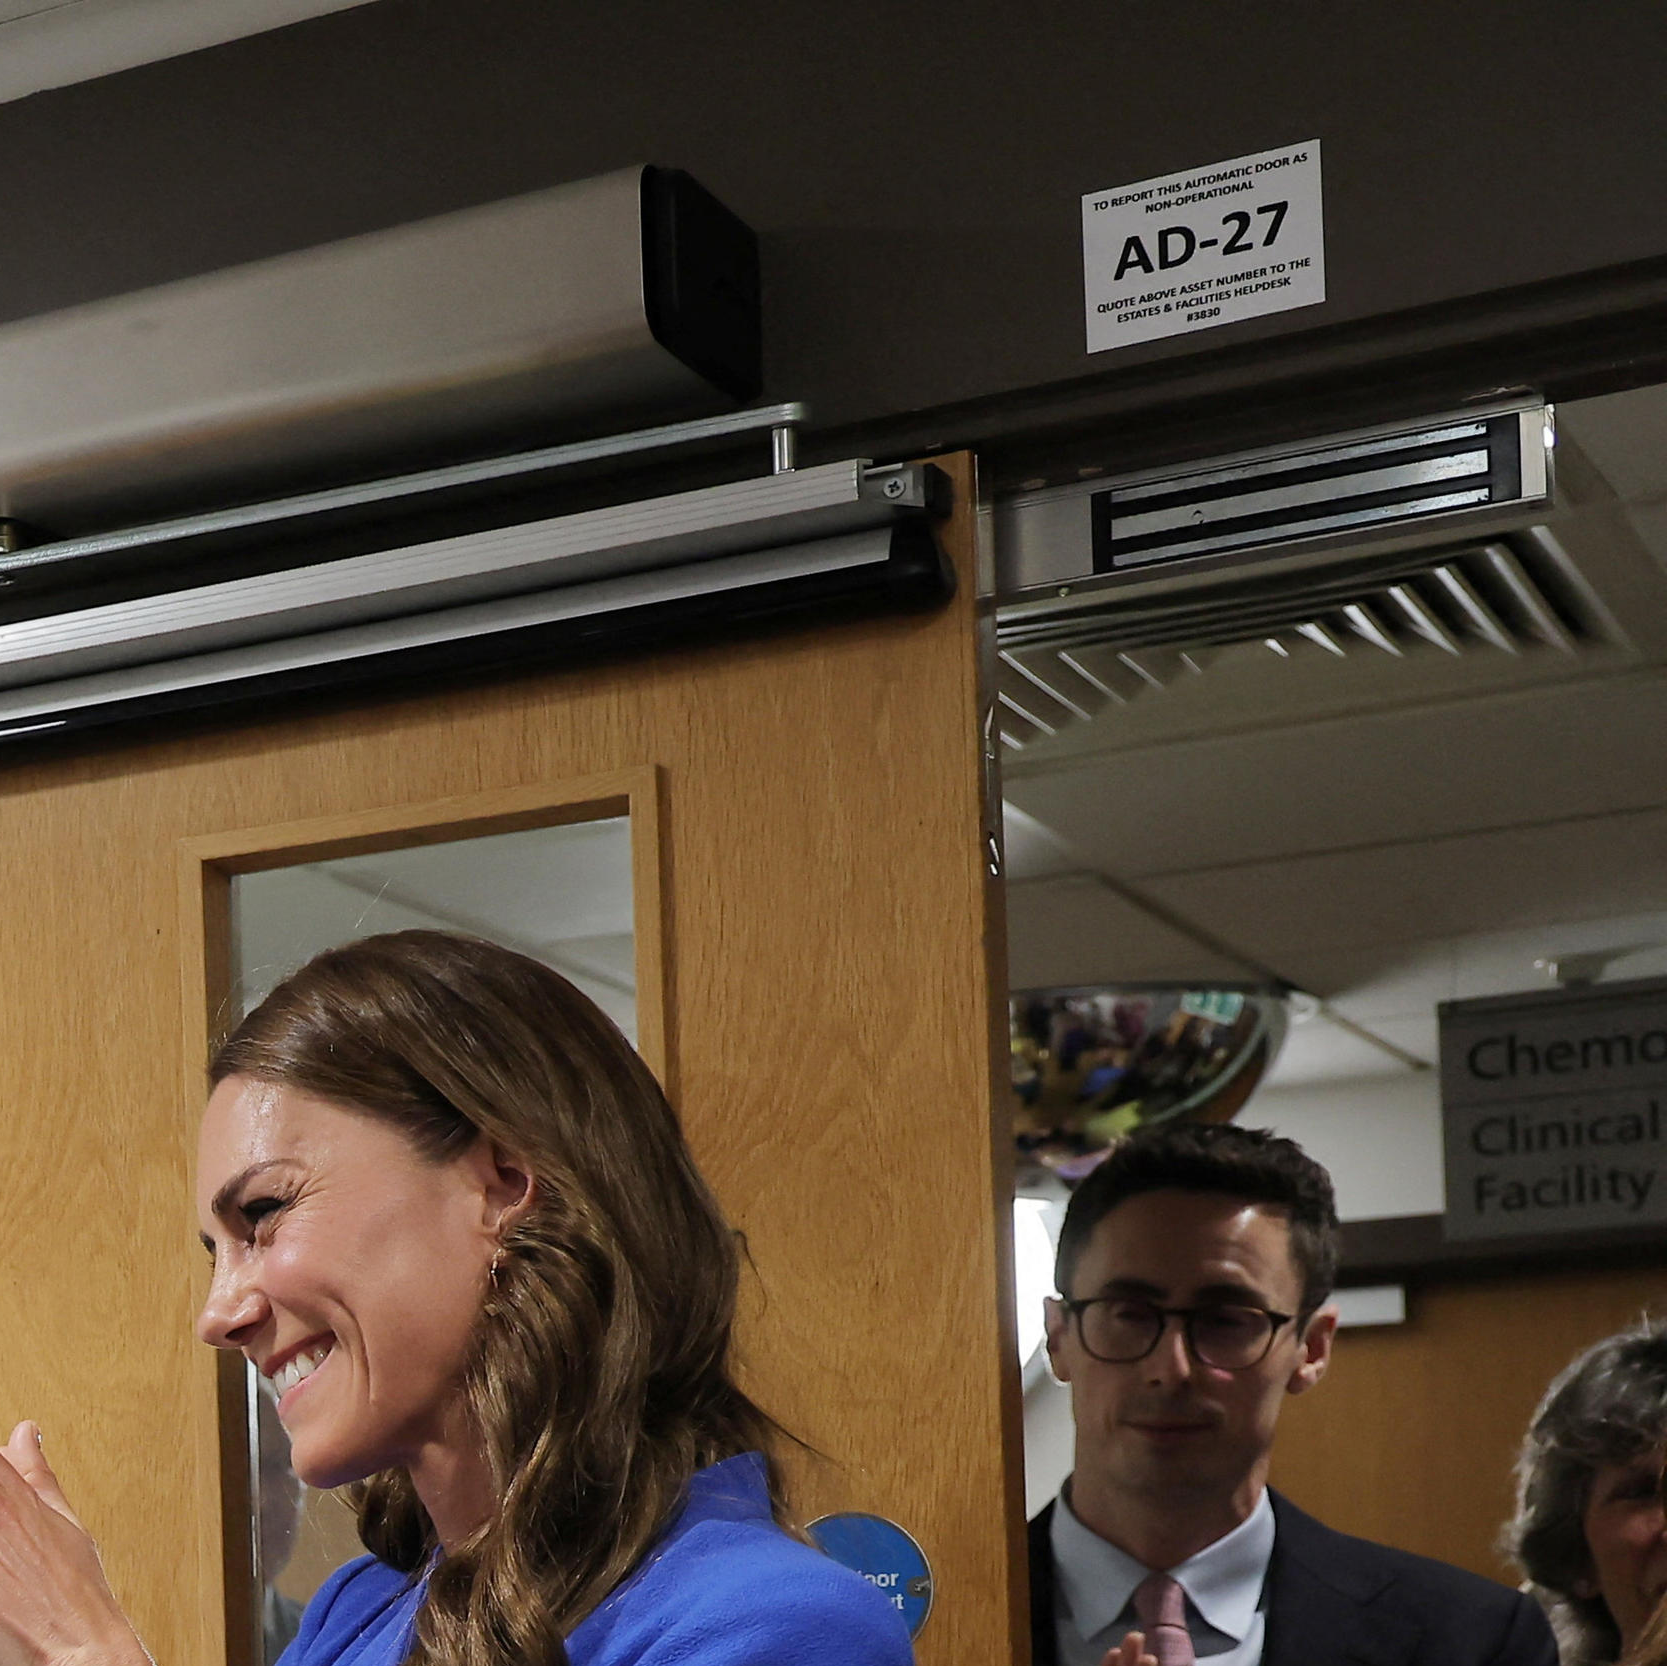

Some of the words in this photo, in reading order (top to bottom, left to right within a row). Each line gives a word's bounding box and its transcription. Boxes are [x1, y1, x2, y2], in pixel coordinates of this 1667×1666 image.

[1093, 200, 1108, 211] TO
[1111, 190, 1154, 207] REPORT
[1156, 184, 1181, 198] THIS
[1185, 165, 1253, 191] AUTOMATIC
[1255, 157, 1289, 173] DOOR
[1293, 152, 1308, 165] AS
[1145, 180, 1254, 213] NON-OPERATIONAL
[1114, 201, 1289, 281] AD-27
[1097, 297, 1136, 314] QUOTE
[1138, 288, 1177, 304] ABOVE
[1180, 280, 1213, 295] ASSET
[1216, 268, 1267, 285] NUMBER
[1270, 264, 1285, 275] TO
[1289, 258, 1311, 270] THE
[1117, 305, 1161, 323] ESTATES
[1163, 303, 1172, 312] &
[1176, 290, 1231, 310] FACILITIES
[1234, 277, 1291, 297] HELPDESK
[1472, 1101, 1660, 1156] Clinical
[1475, 1165, 1657, 1215] Facility
